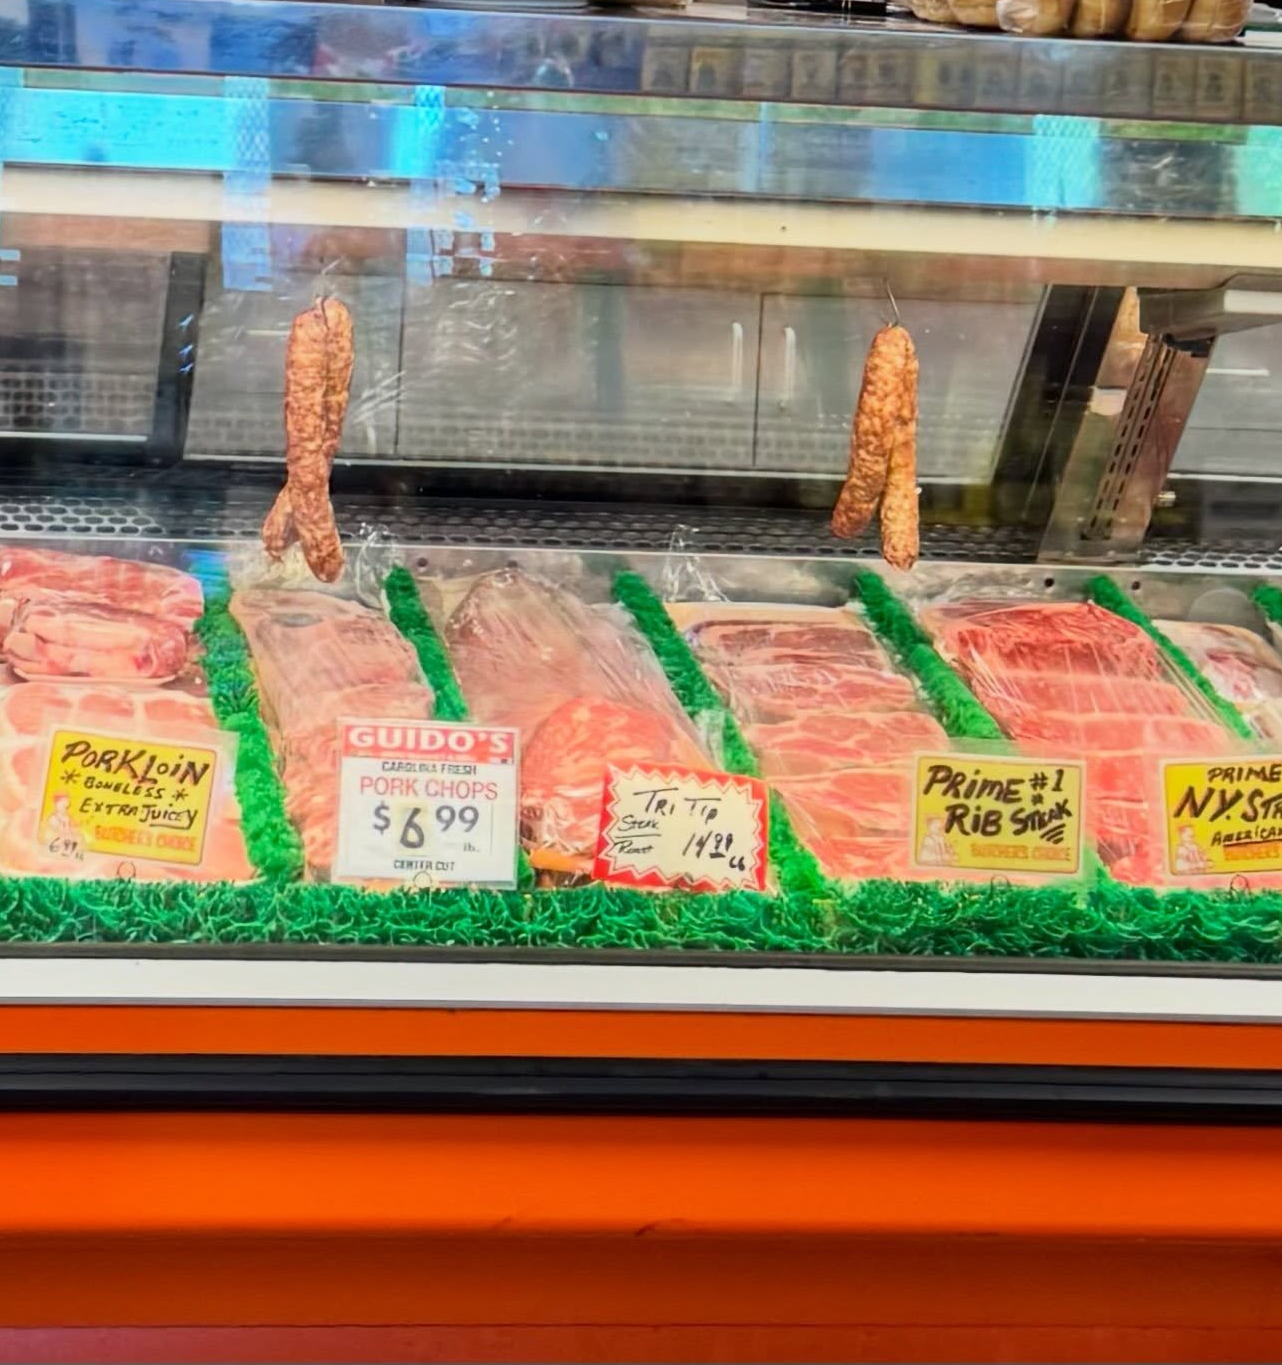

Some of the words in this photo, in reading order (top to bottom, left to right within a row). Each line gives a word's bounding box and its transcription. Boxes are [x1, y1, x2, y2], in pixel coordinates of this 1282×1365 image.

[349, 727, 509, 754] GUIDO'S
[382, 761, 438, 775] CAROLINA
[441, 762, 477, 776] FRESH
[1207, 764, 1282, 784] PRIME
[84, 776, 165, 800] BONELESS
[360, 776, 419, 797] PORK
[424, 779, 499, 800] CHOPS
[80, 797, 138, 817] EXTRA
[633, 787, 679, 817] TRI
[393, 859, 432, 871] CENTER
[436, 860, 456, 871] CUT
